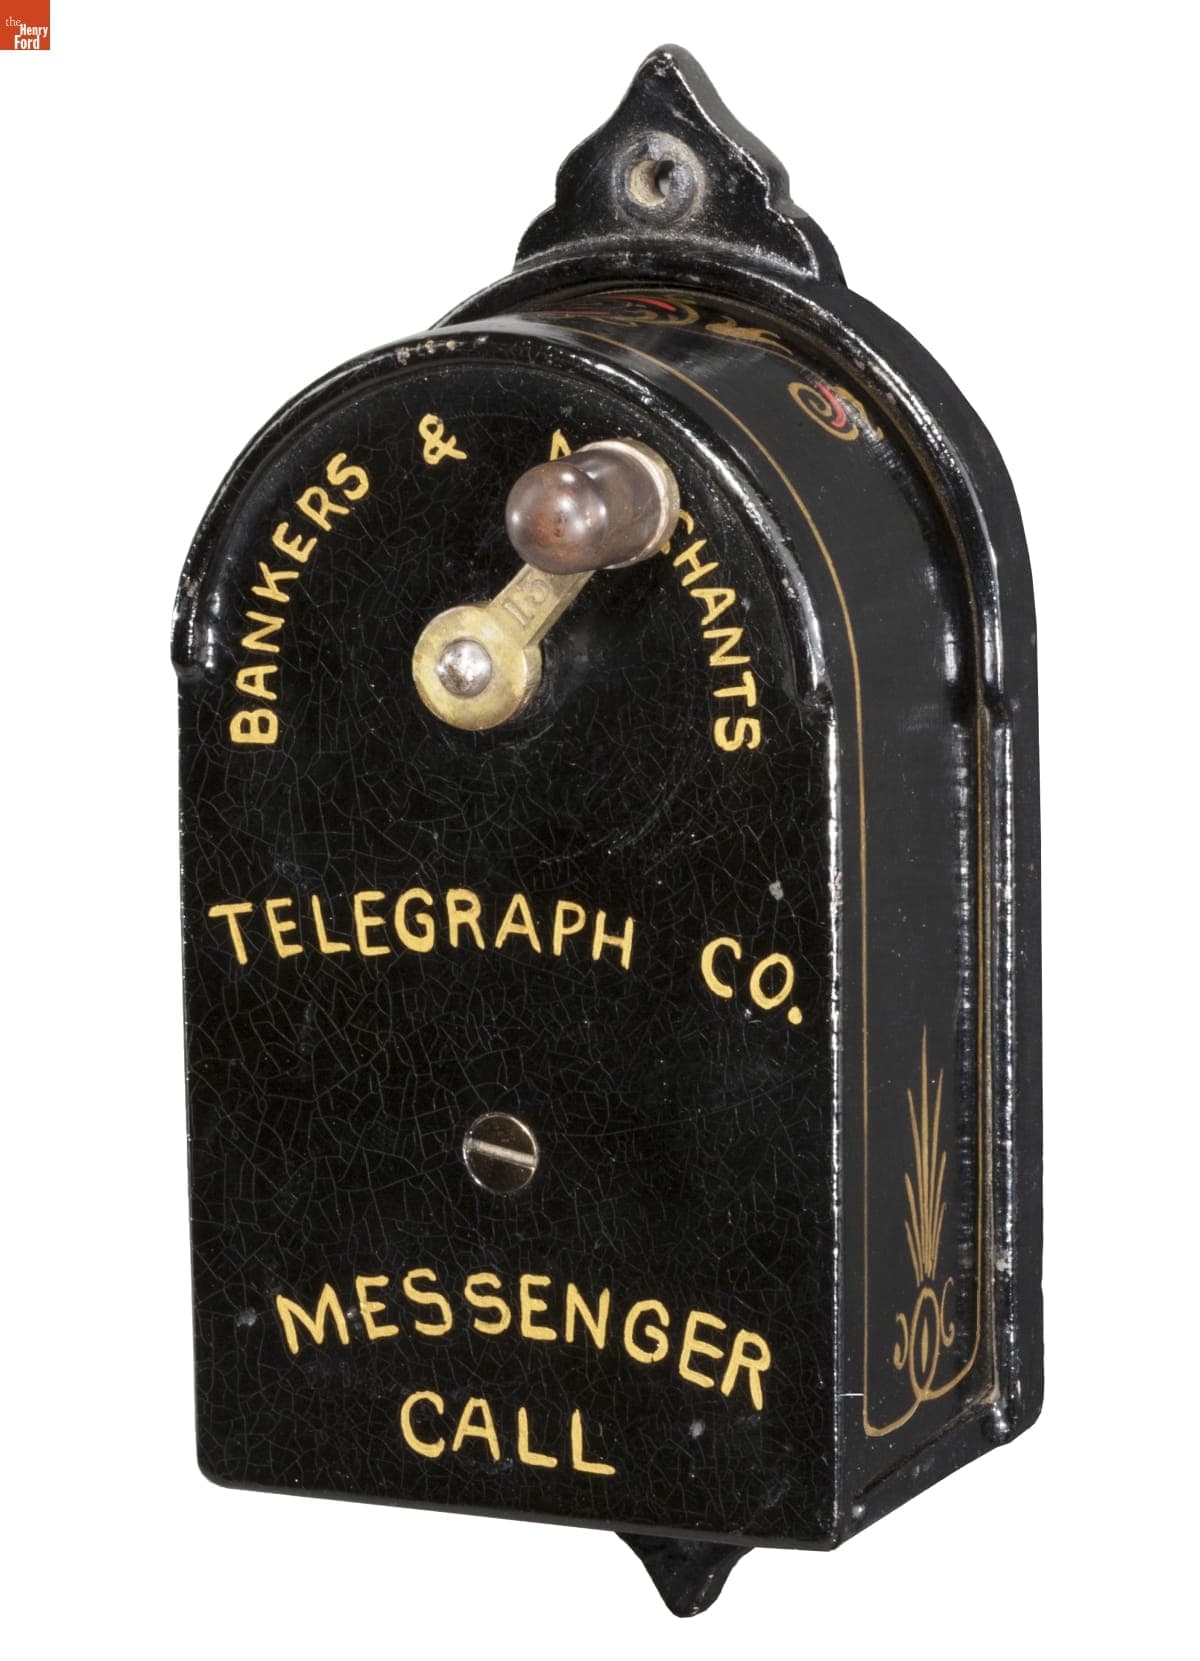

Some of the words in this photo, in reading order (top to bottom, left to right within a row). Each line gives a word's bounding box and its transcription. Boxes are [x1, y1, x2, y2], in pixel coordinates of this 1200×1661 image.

[229, 452, 370, 745] BANKERS
[418, 413, 467, 465] &
[207, 887, 635, 970] TELEGRAPH
[700, 936, 804, 1026] CO.
[275, 1267, 772, 1411] MESSENGER
[400, 1390, 616, 1476] CALL
